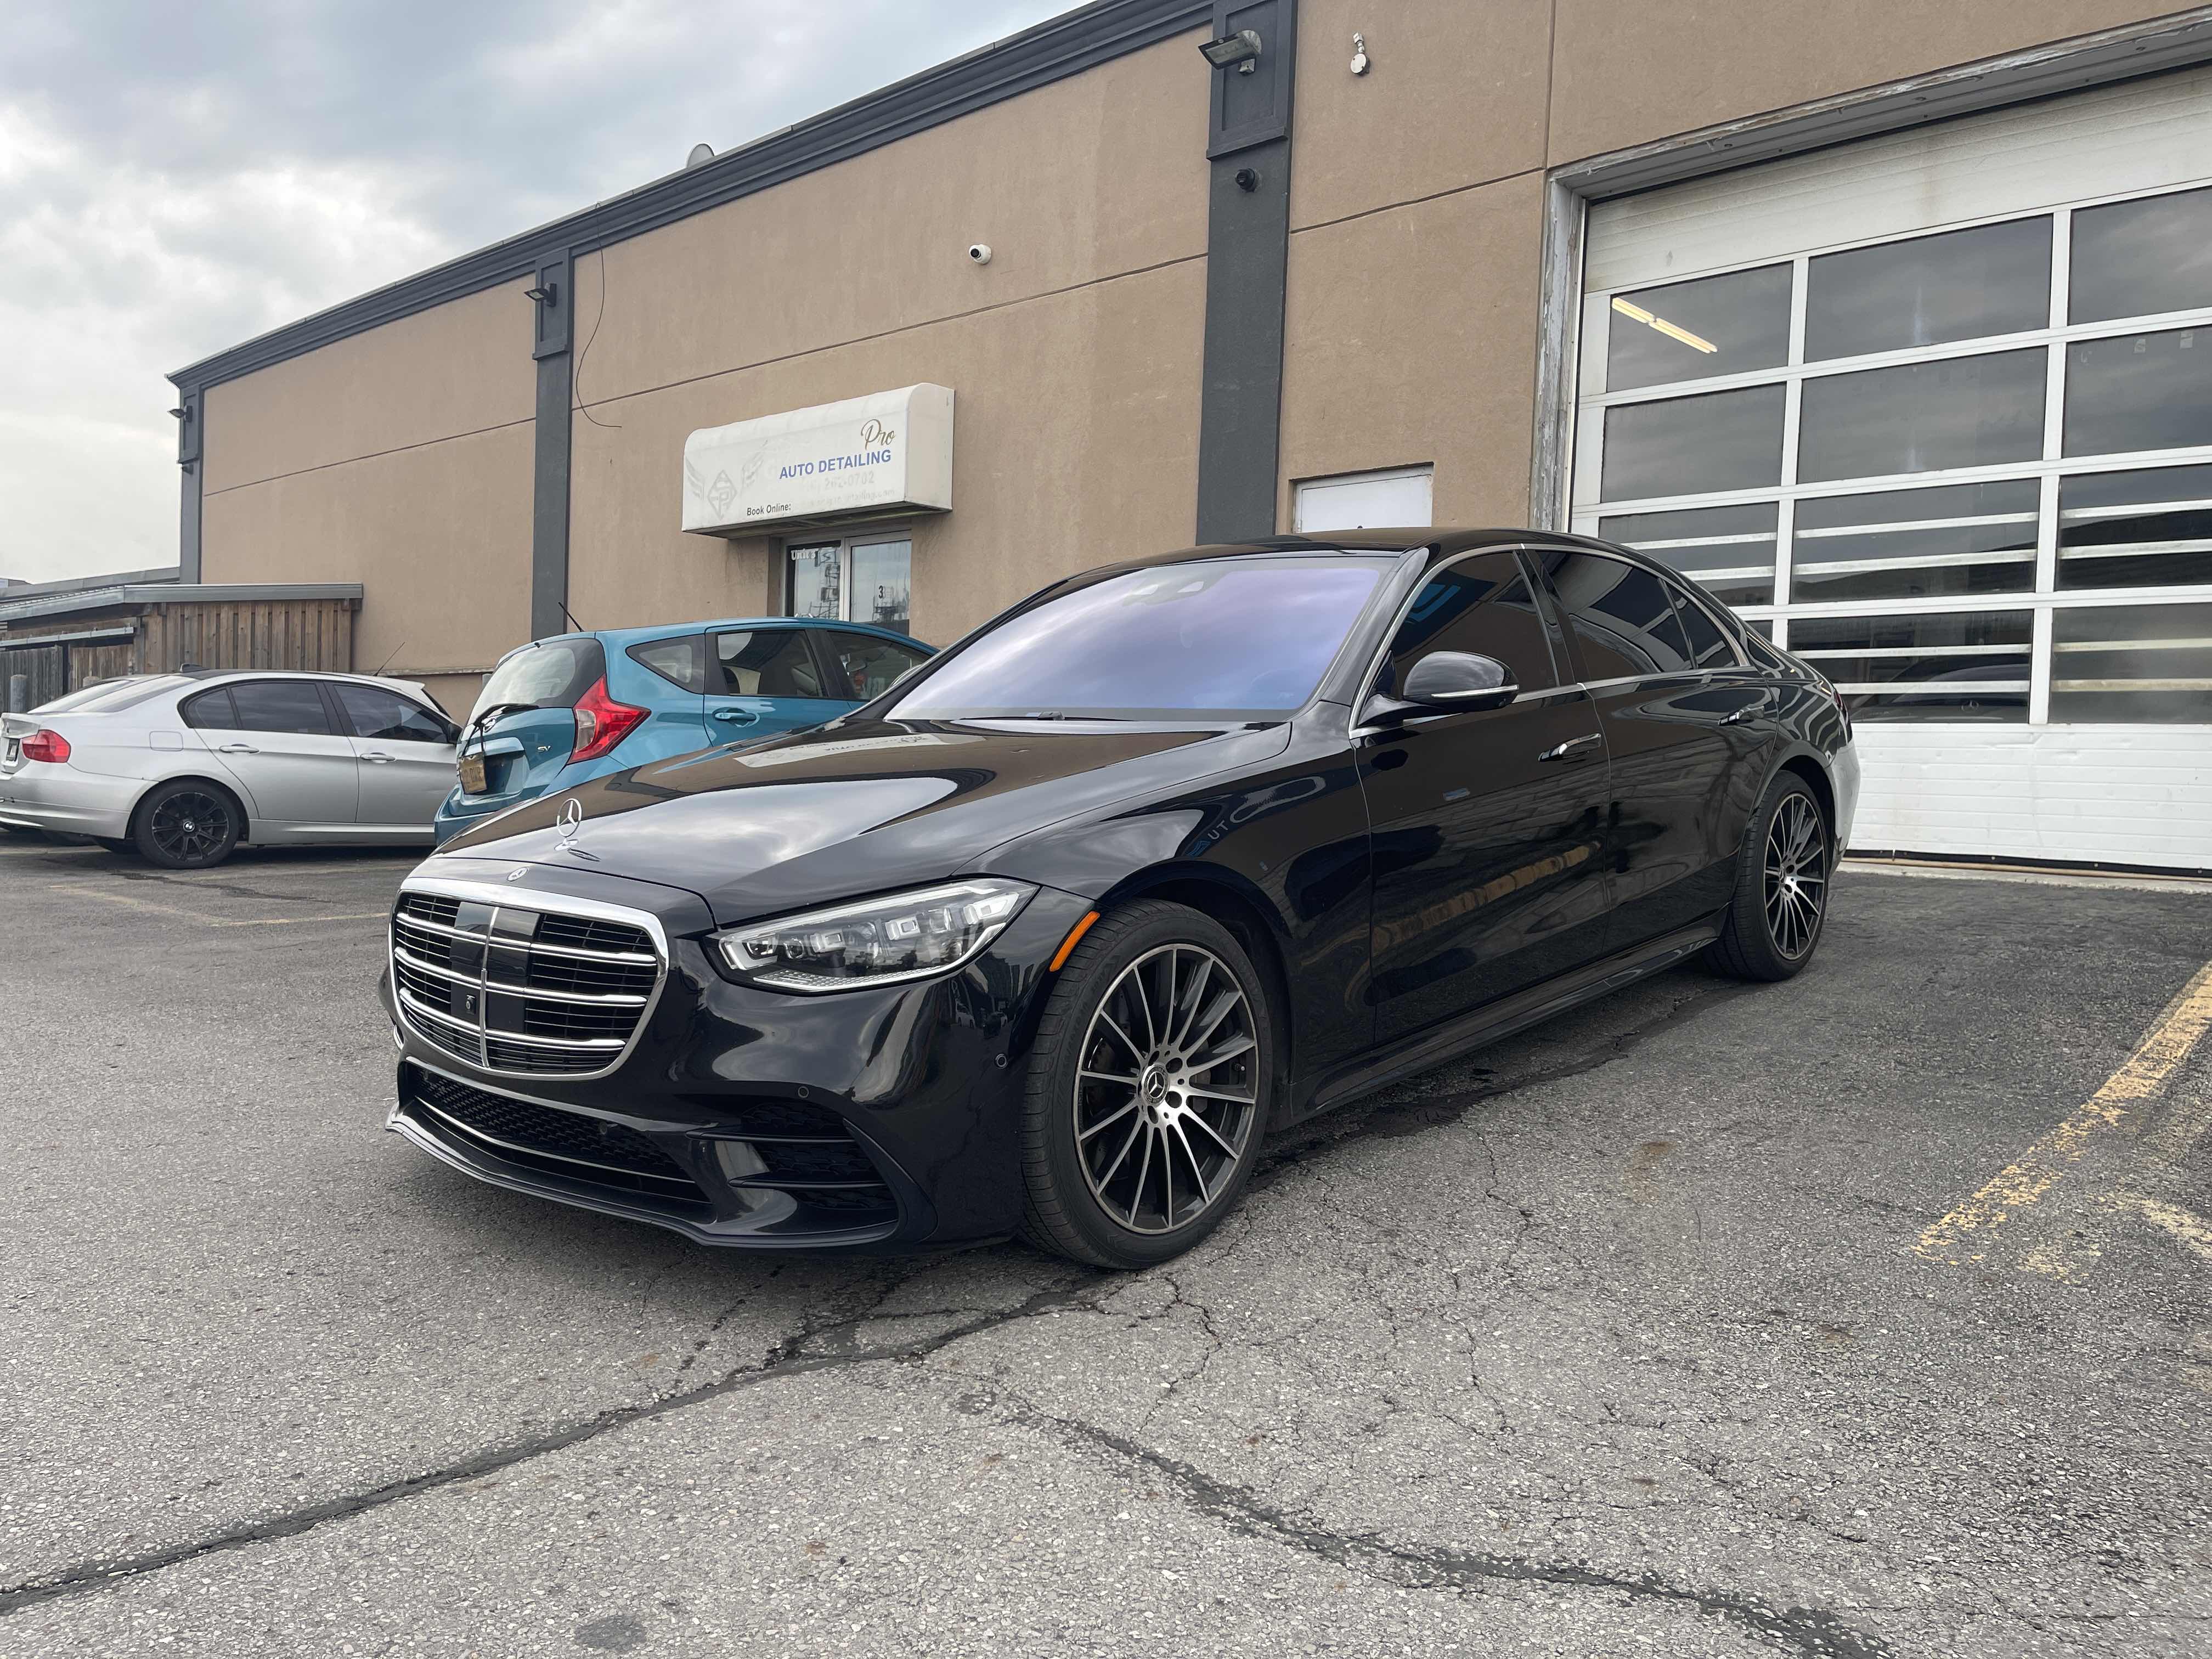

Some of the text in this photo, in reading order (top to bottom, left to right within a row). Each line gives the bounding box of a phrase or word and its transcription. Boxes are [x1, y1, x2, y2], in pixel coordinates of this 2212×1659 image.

[861, 419, 896, 450] Pro
[780, 449, 891, 479] AUTO DETAILING
[747, 503, 791, 516] Book Online:
